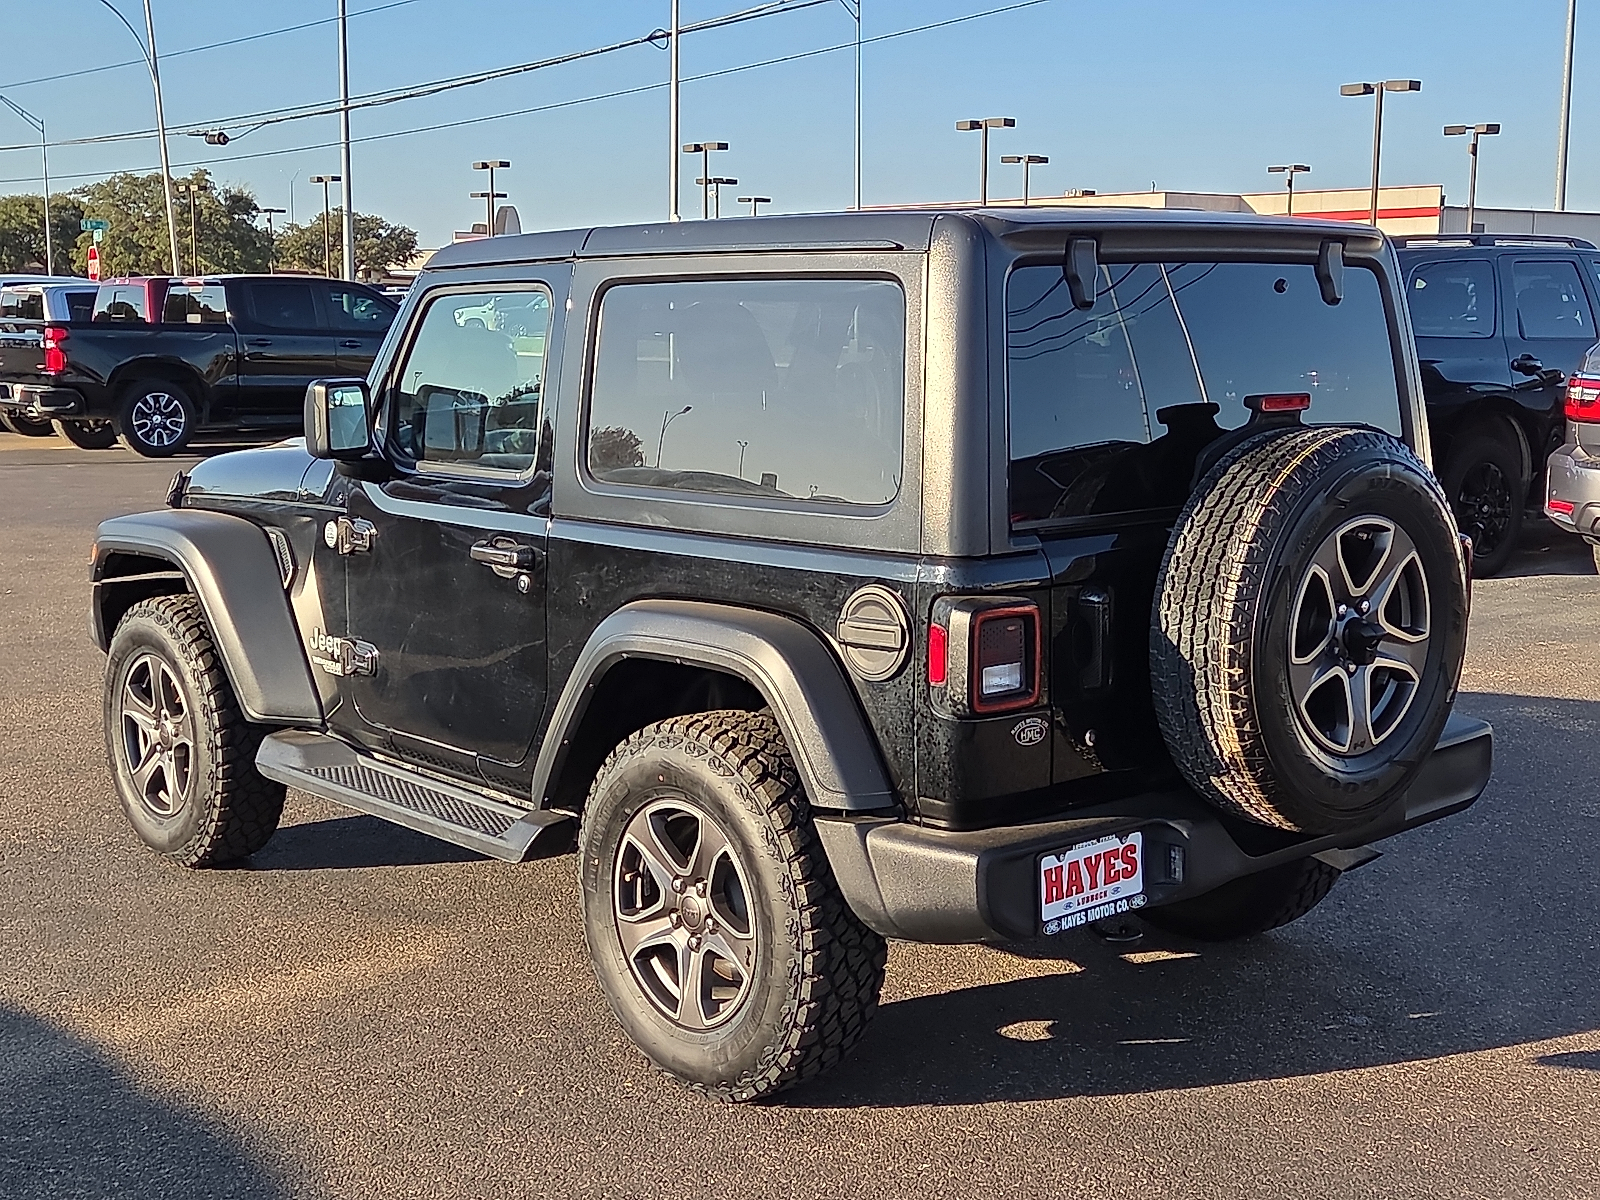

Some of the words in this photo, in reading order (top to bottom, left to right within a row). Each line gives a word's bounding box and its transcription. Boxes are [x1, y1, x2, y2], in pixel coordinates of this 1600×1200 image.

[309, 626, 341, 660] Jeep
[1020, 726, 1041, 742] HMC
[1043, 843, 1138, 905] HAYES
[1076, 889, 1108, 907] LUBBOCK
[1061, 911, 1086, 931] HAYES
[1087, 903, 1115, 922] MOTOR
[1115, 899, 1130, 914] CO.
